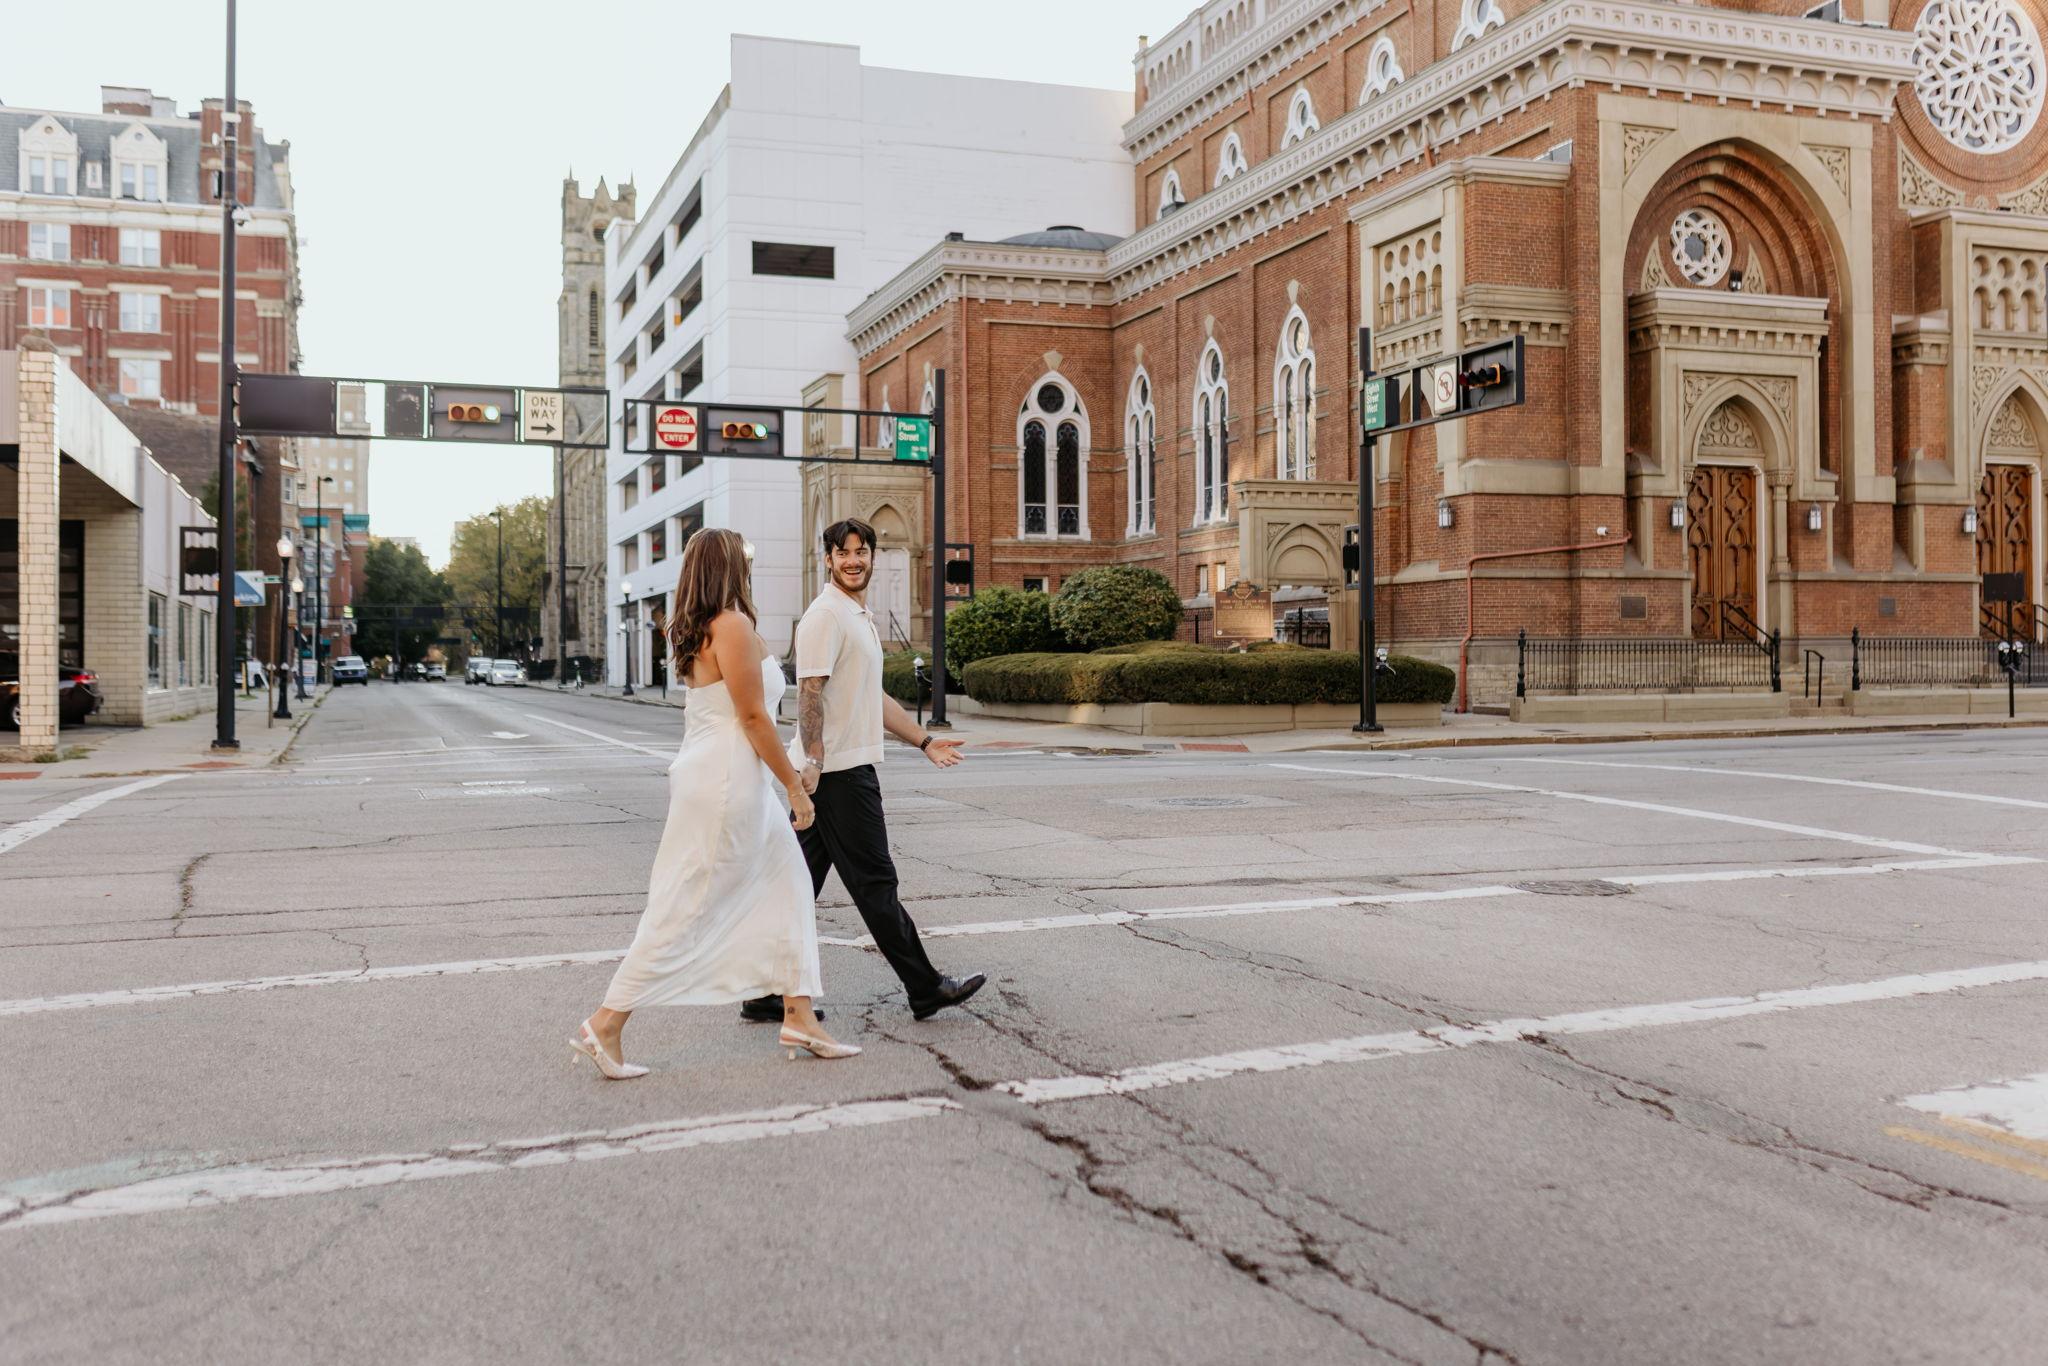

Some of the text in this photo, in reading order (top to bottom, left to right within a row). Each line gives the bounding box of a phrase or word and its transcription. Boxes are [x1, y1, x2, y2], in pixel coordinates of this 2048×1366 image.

[531, 397, 556, 407] ONE
[530, 408, 557, 420] WAY
[661, 413, 690, 424] DO NOT
[898, 421, 916, 431] Plum
[663, 433, 689, 442] ENTER
[898, 431, 920, 442] Street
